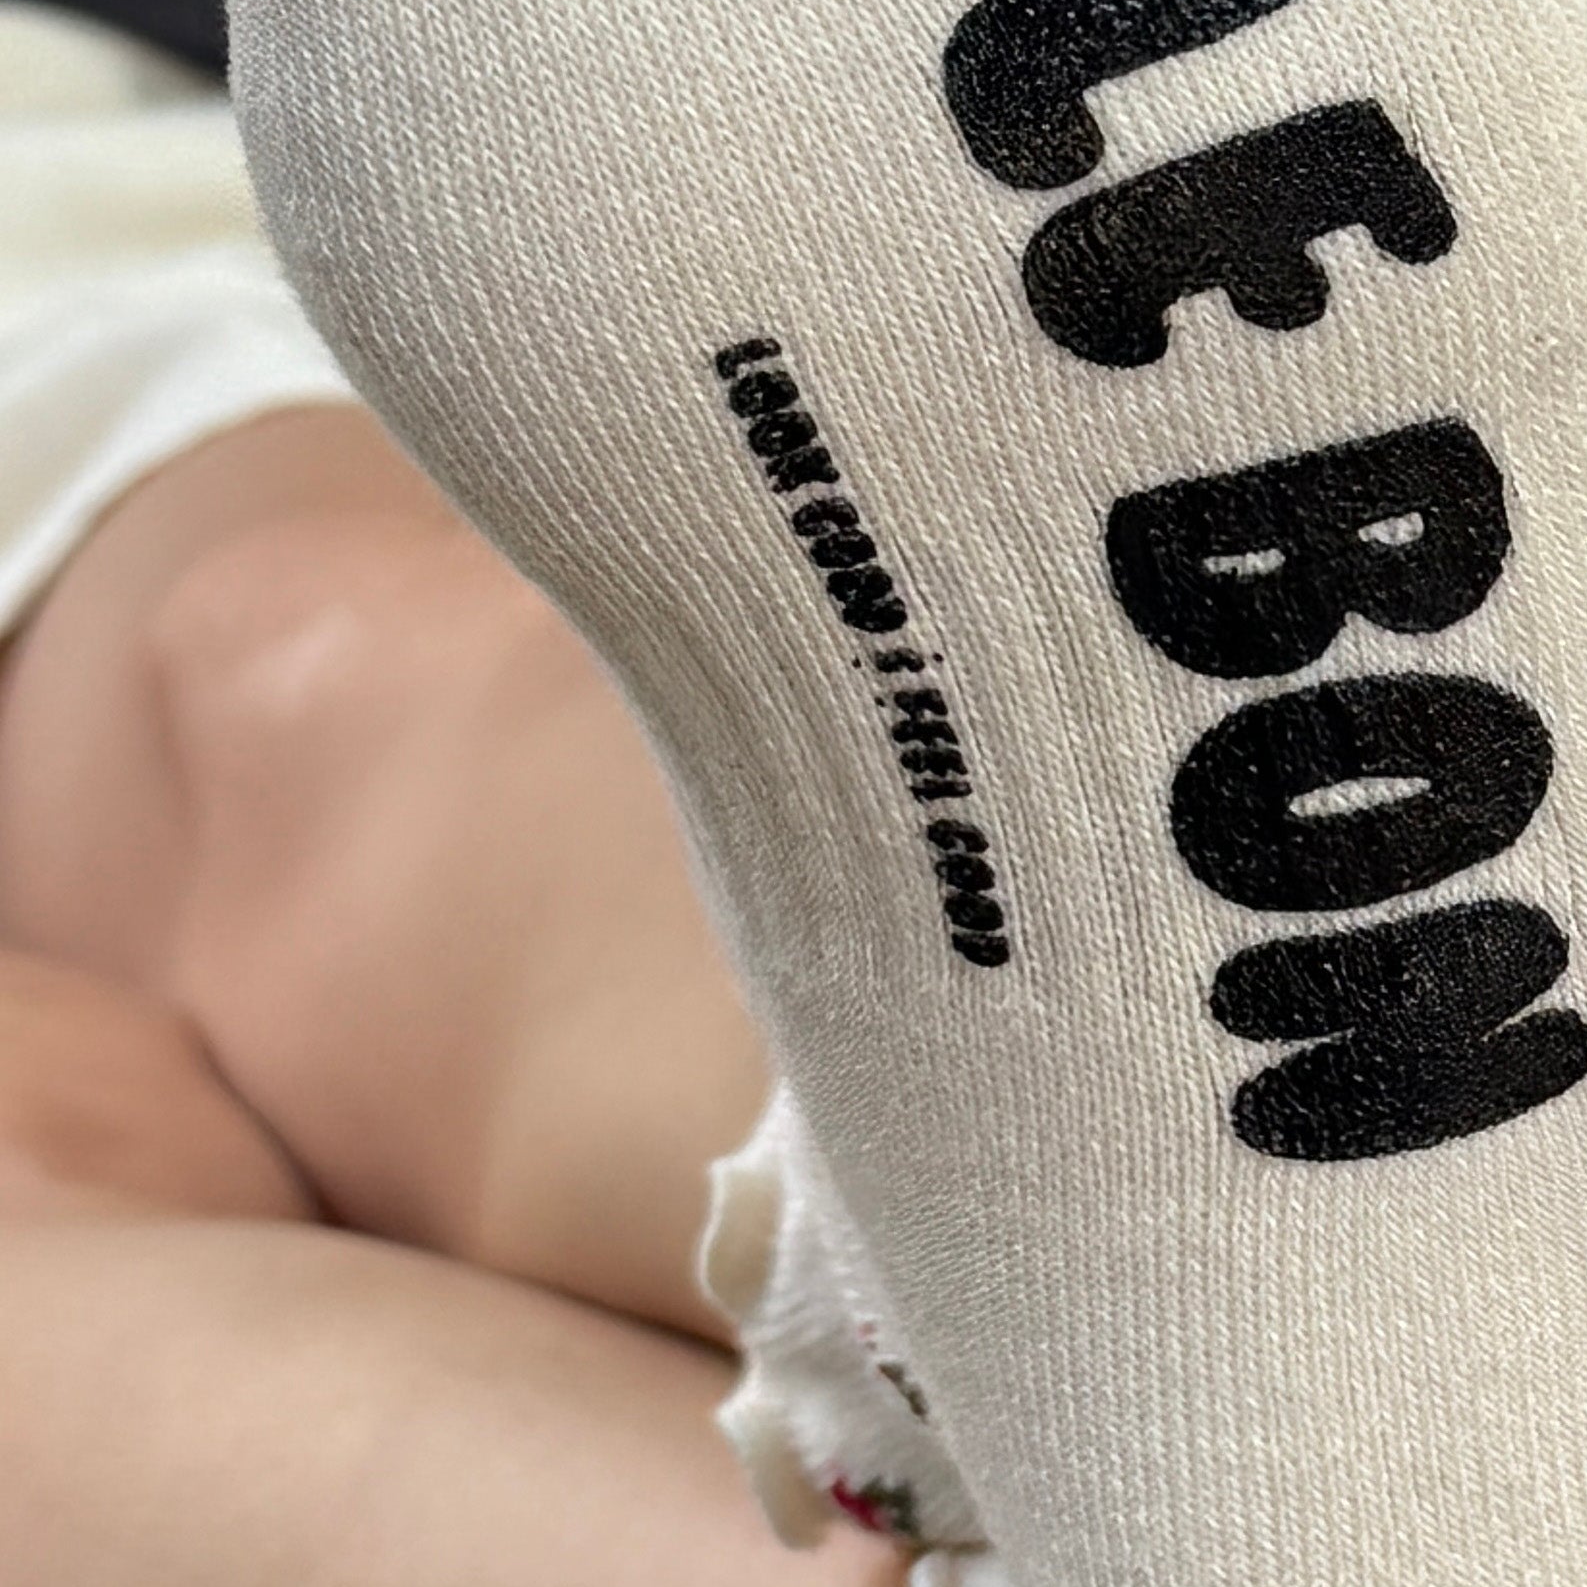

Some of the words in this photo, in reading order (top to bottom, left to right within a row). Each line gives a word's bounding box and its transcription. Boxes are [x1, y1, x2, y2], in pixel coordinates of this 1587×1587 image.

[714, 337, 841, 495] LOOK
[791, 496, 908, 635] GOOD
[890, 687, 973, 804] FEEL
[925, 817, 1011, 969] GOOD
